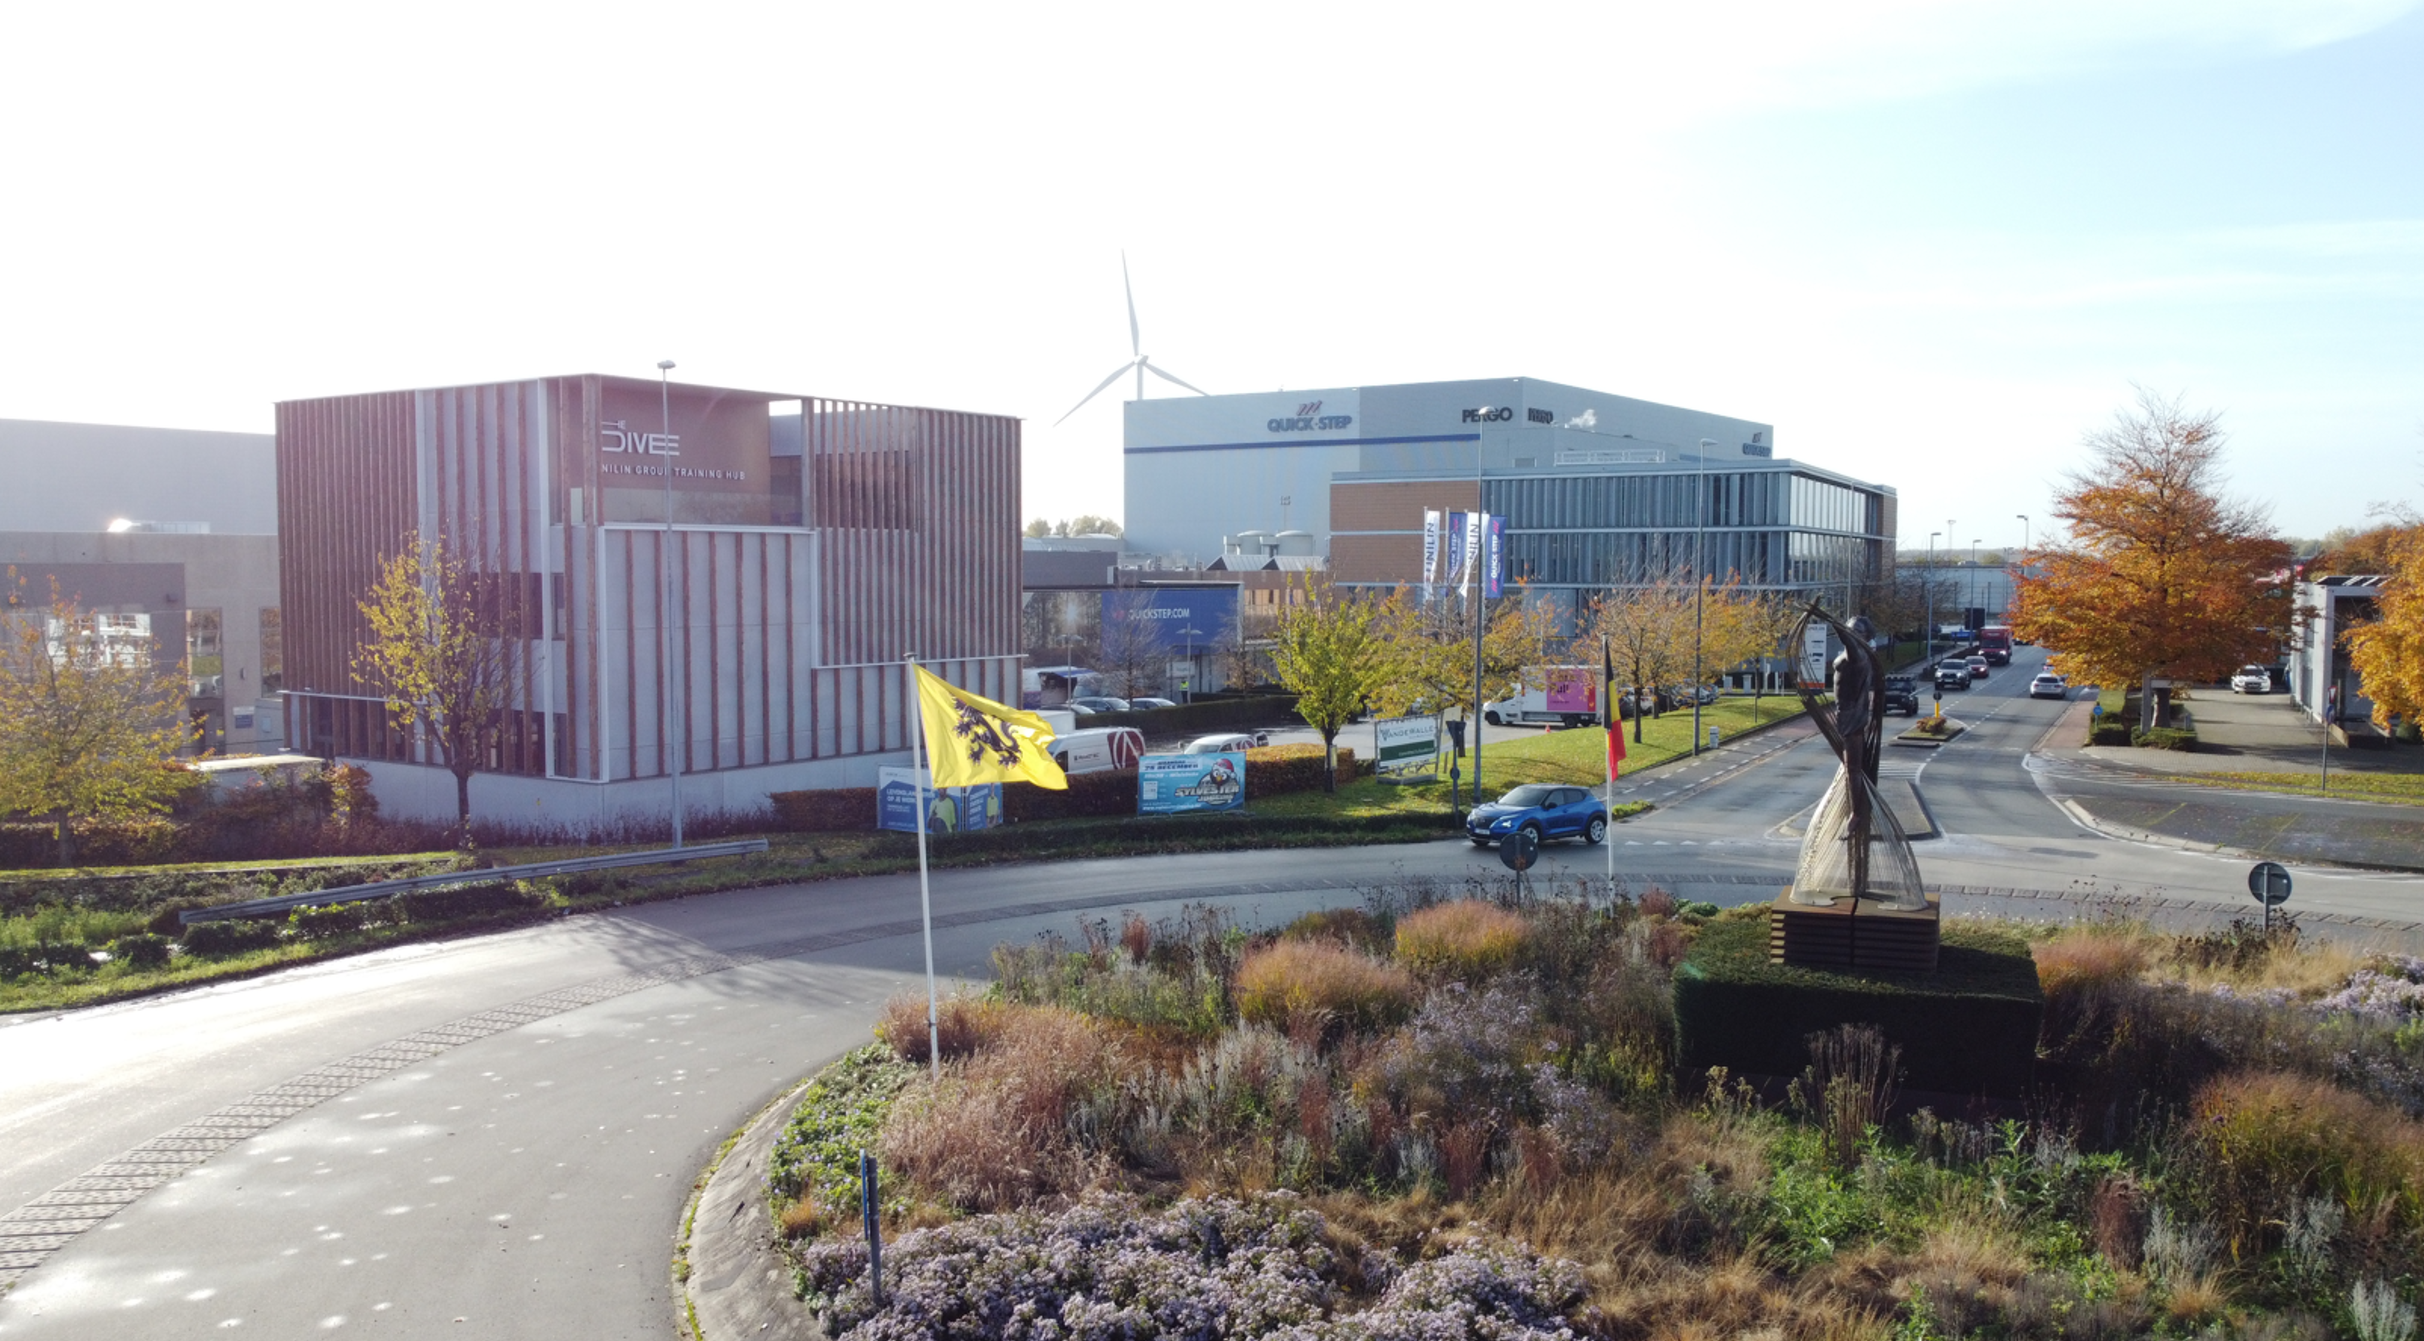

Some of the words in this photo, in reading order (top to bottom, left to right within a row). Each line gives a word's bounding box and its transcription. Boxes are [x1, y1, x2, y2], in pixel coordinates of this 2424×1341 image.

[602, 464, 631, 474] NILIN
[674, 467, 722, 478] TRAINING
[726, 470, 746, 480] HUB
